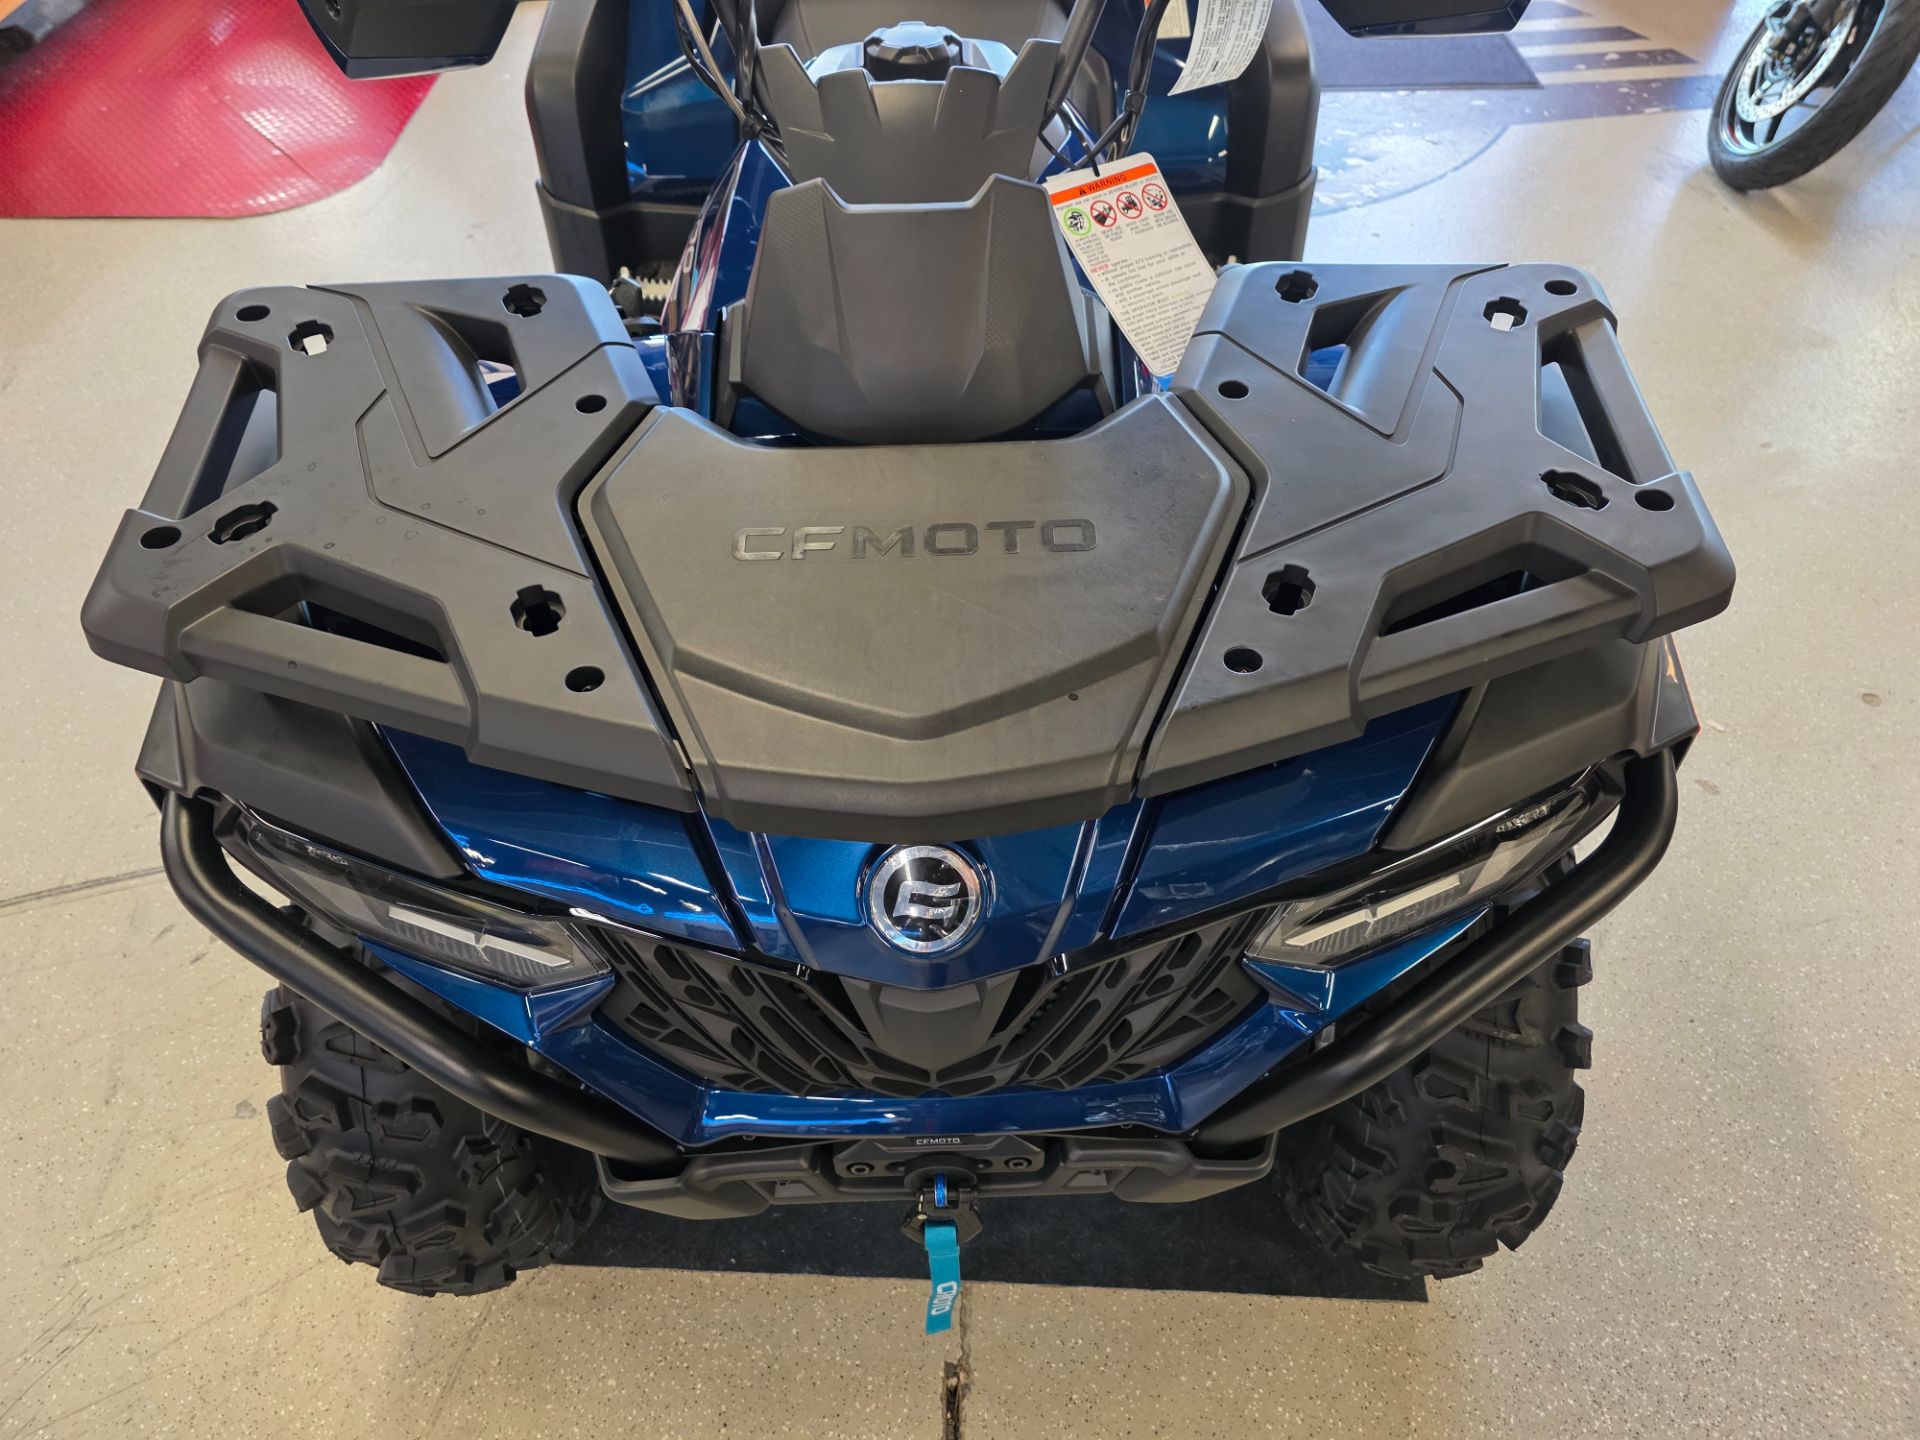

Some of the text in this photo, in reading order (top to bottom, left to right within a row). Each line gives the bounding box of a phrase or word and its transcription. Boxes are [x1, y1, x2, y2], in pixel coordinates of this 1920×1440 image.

[1088, 174, 1127, 192] WARNING
[1090, 264, 1109, 273] NEVER
[1131, 301, 1155, 313] OPERATOR
[731, 518, 1097, 562] CFMOTO
[916, 1137, 961, 1146] CFMOTO
